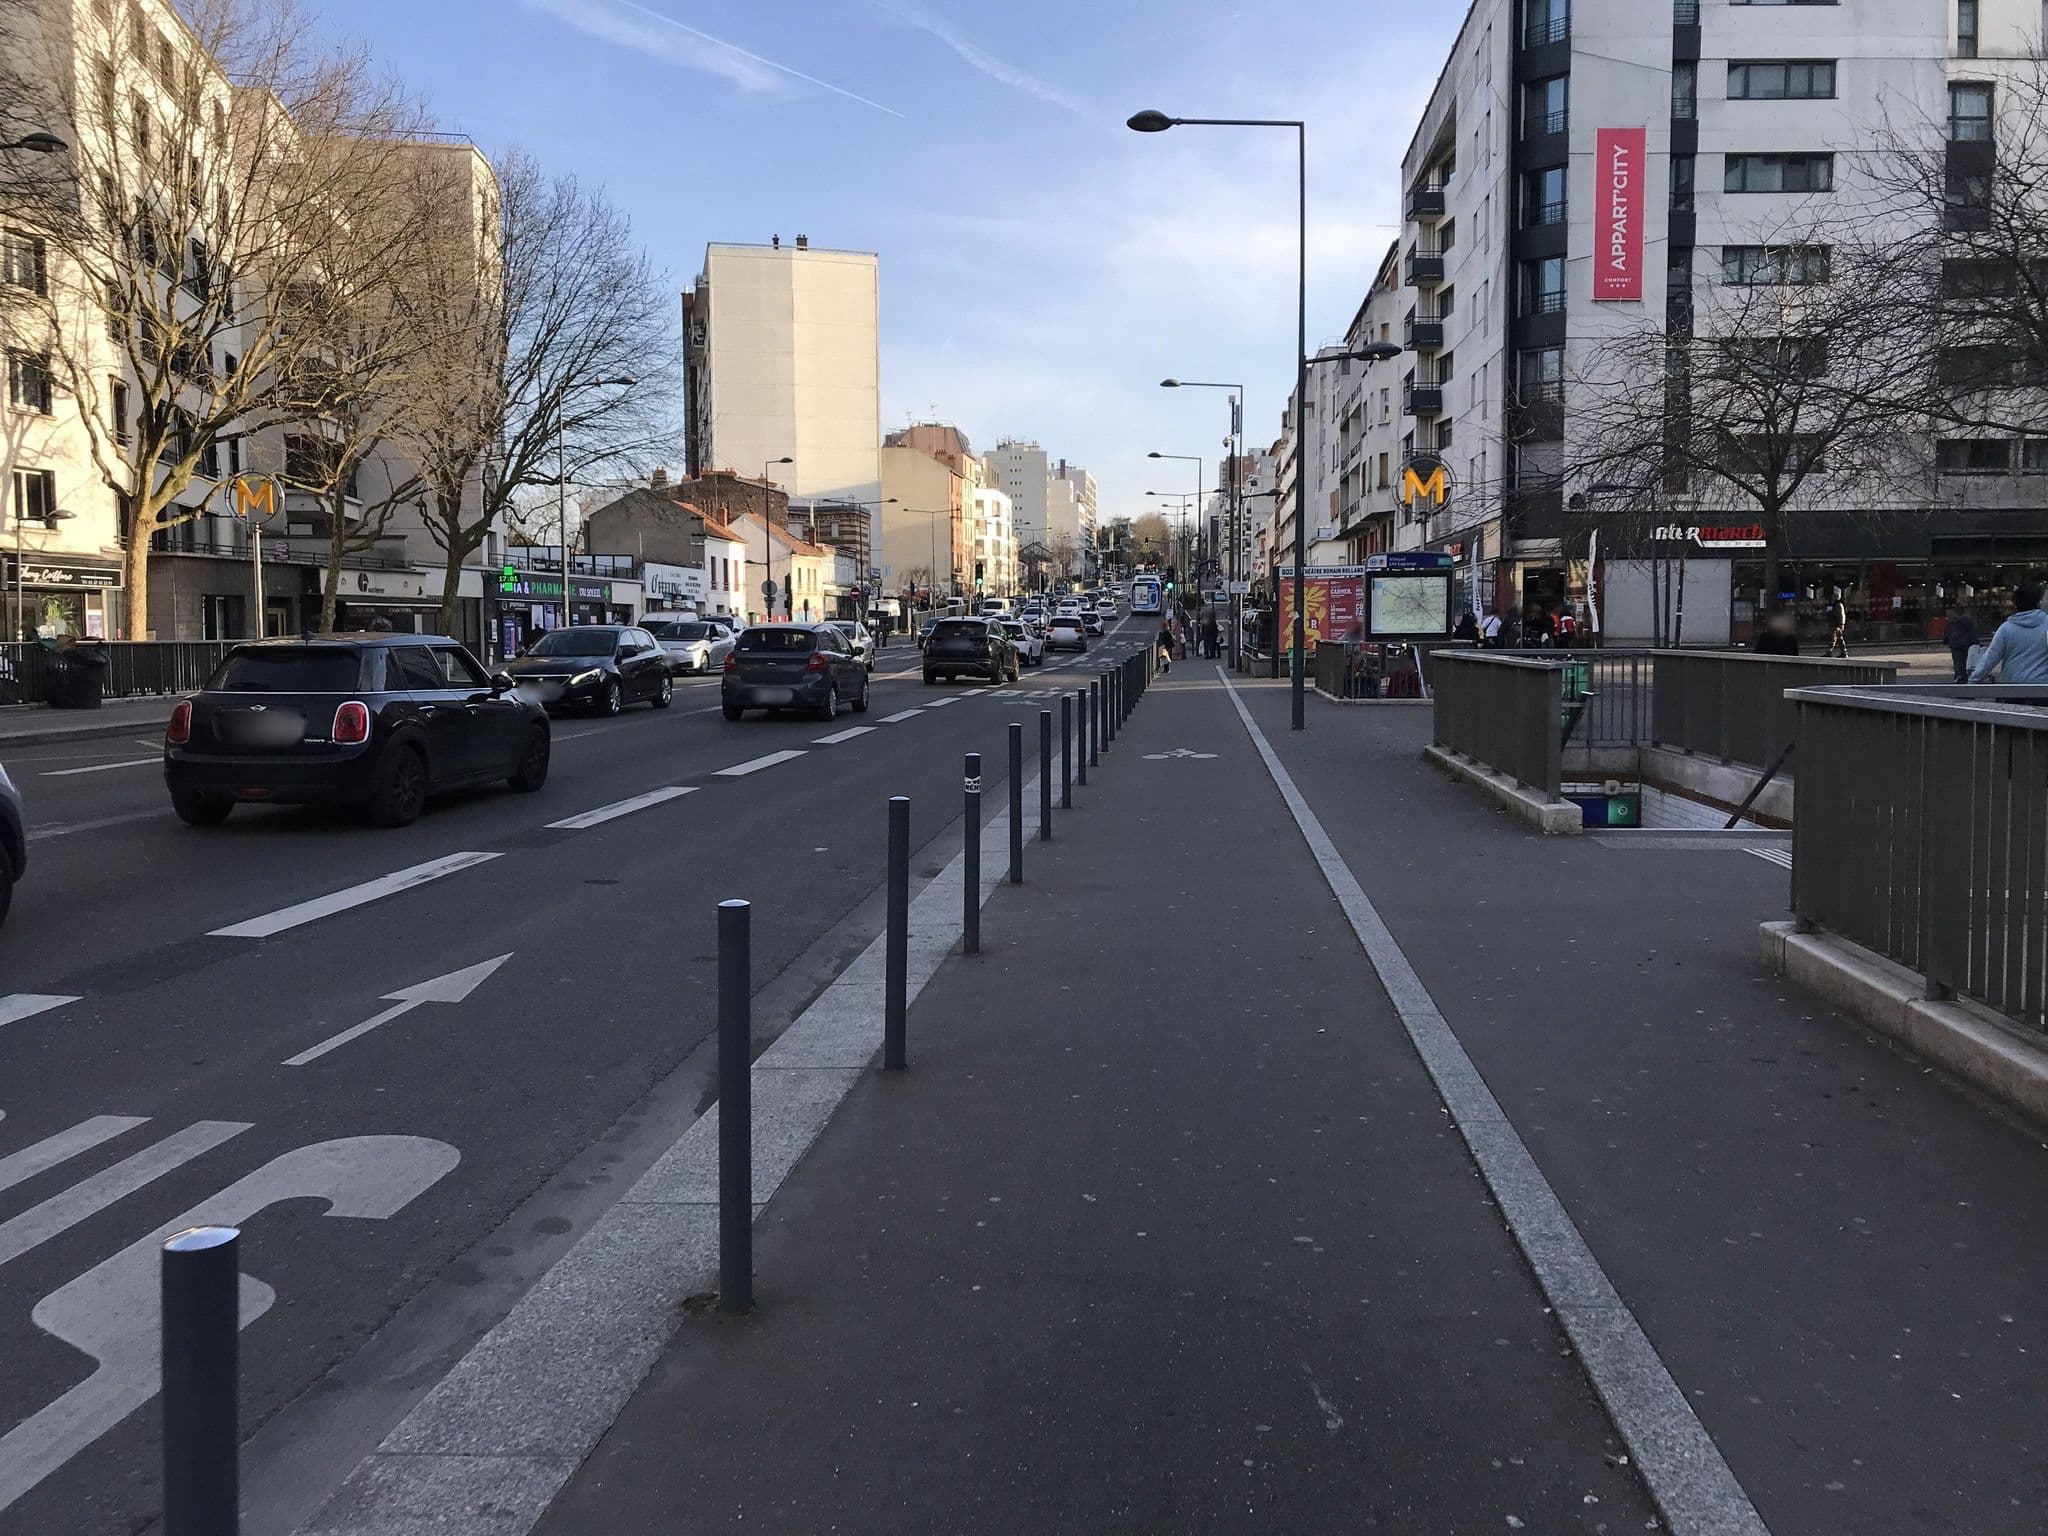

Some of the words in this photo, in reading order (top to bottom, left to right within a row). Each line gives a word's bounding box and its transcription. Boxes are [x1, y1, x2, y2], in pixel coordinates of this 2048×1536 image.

[1611, 144, 1629, 271] APPART'CITY
[236, 477, 274, 515] M
[1403, 465, 1444, 504] M
